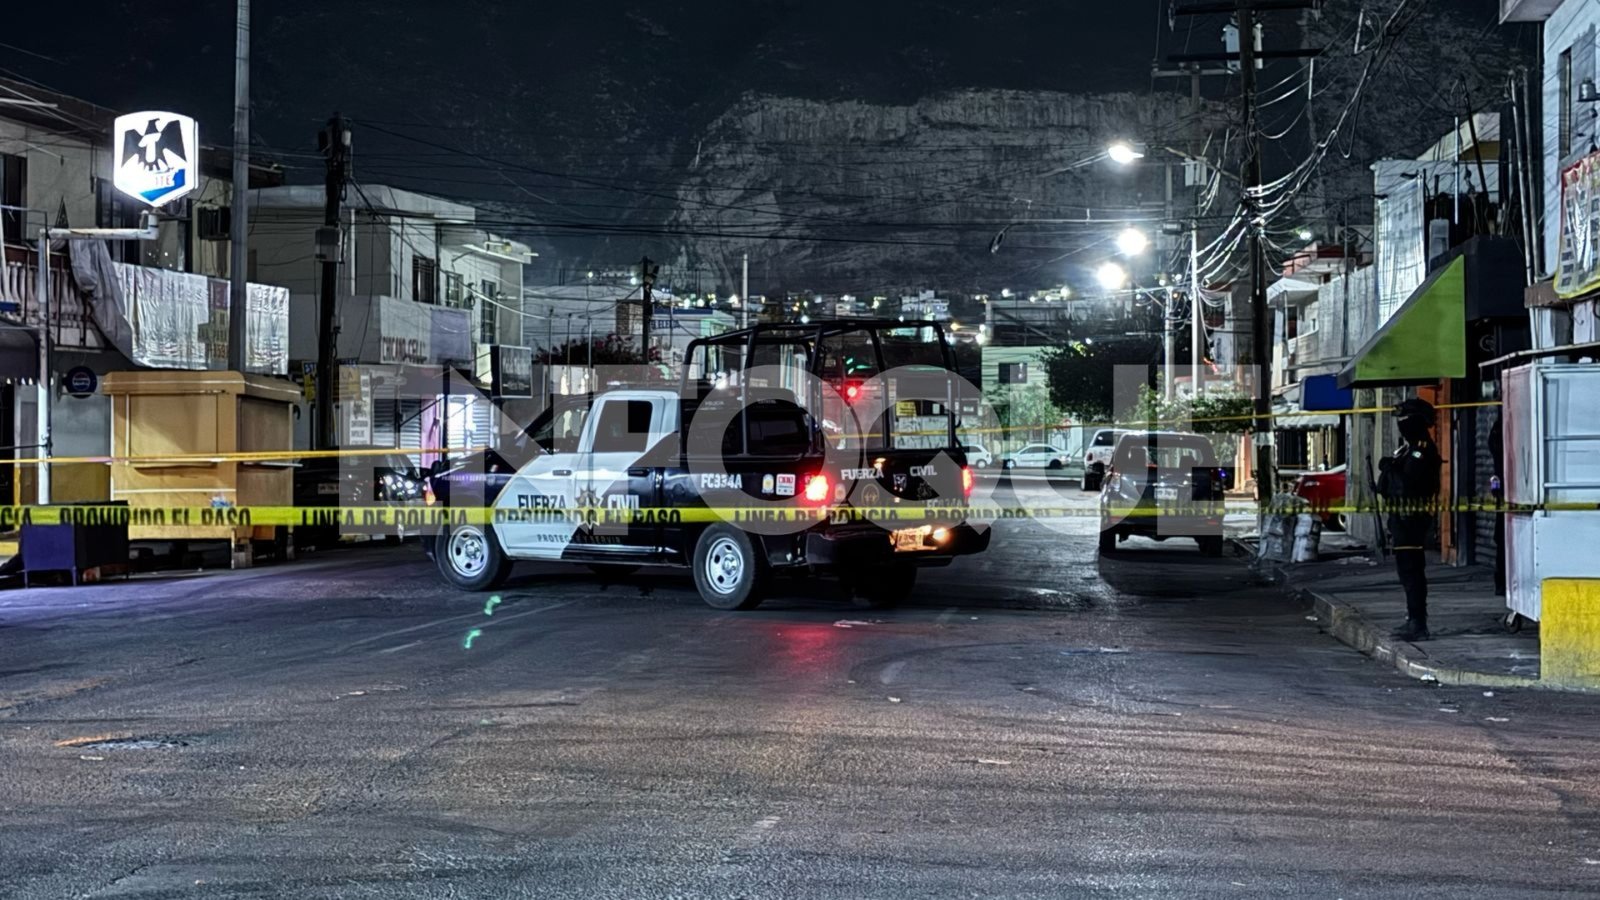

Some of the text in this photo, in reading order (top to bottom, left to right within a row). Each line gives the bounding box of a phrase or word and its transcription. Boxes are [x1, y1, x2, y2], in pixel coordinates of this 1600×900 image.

[840, 464, 938, 481] FUERZA CIVIL
[201, 507, 250, 526] PASO
[302, 509, 468, 526] LINEA DE POLICIA
[734, 508, 791, 523] LINEA
